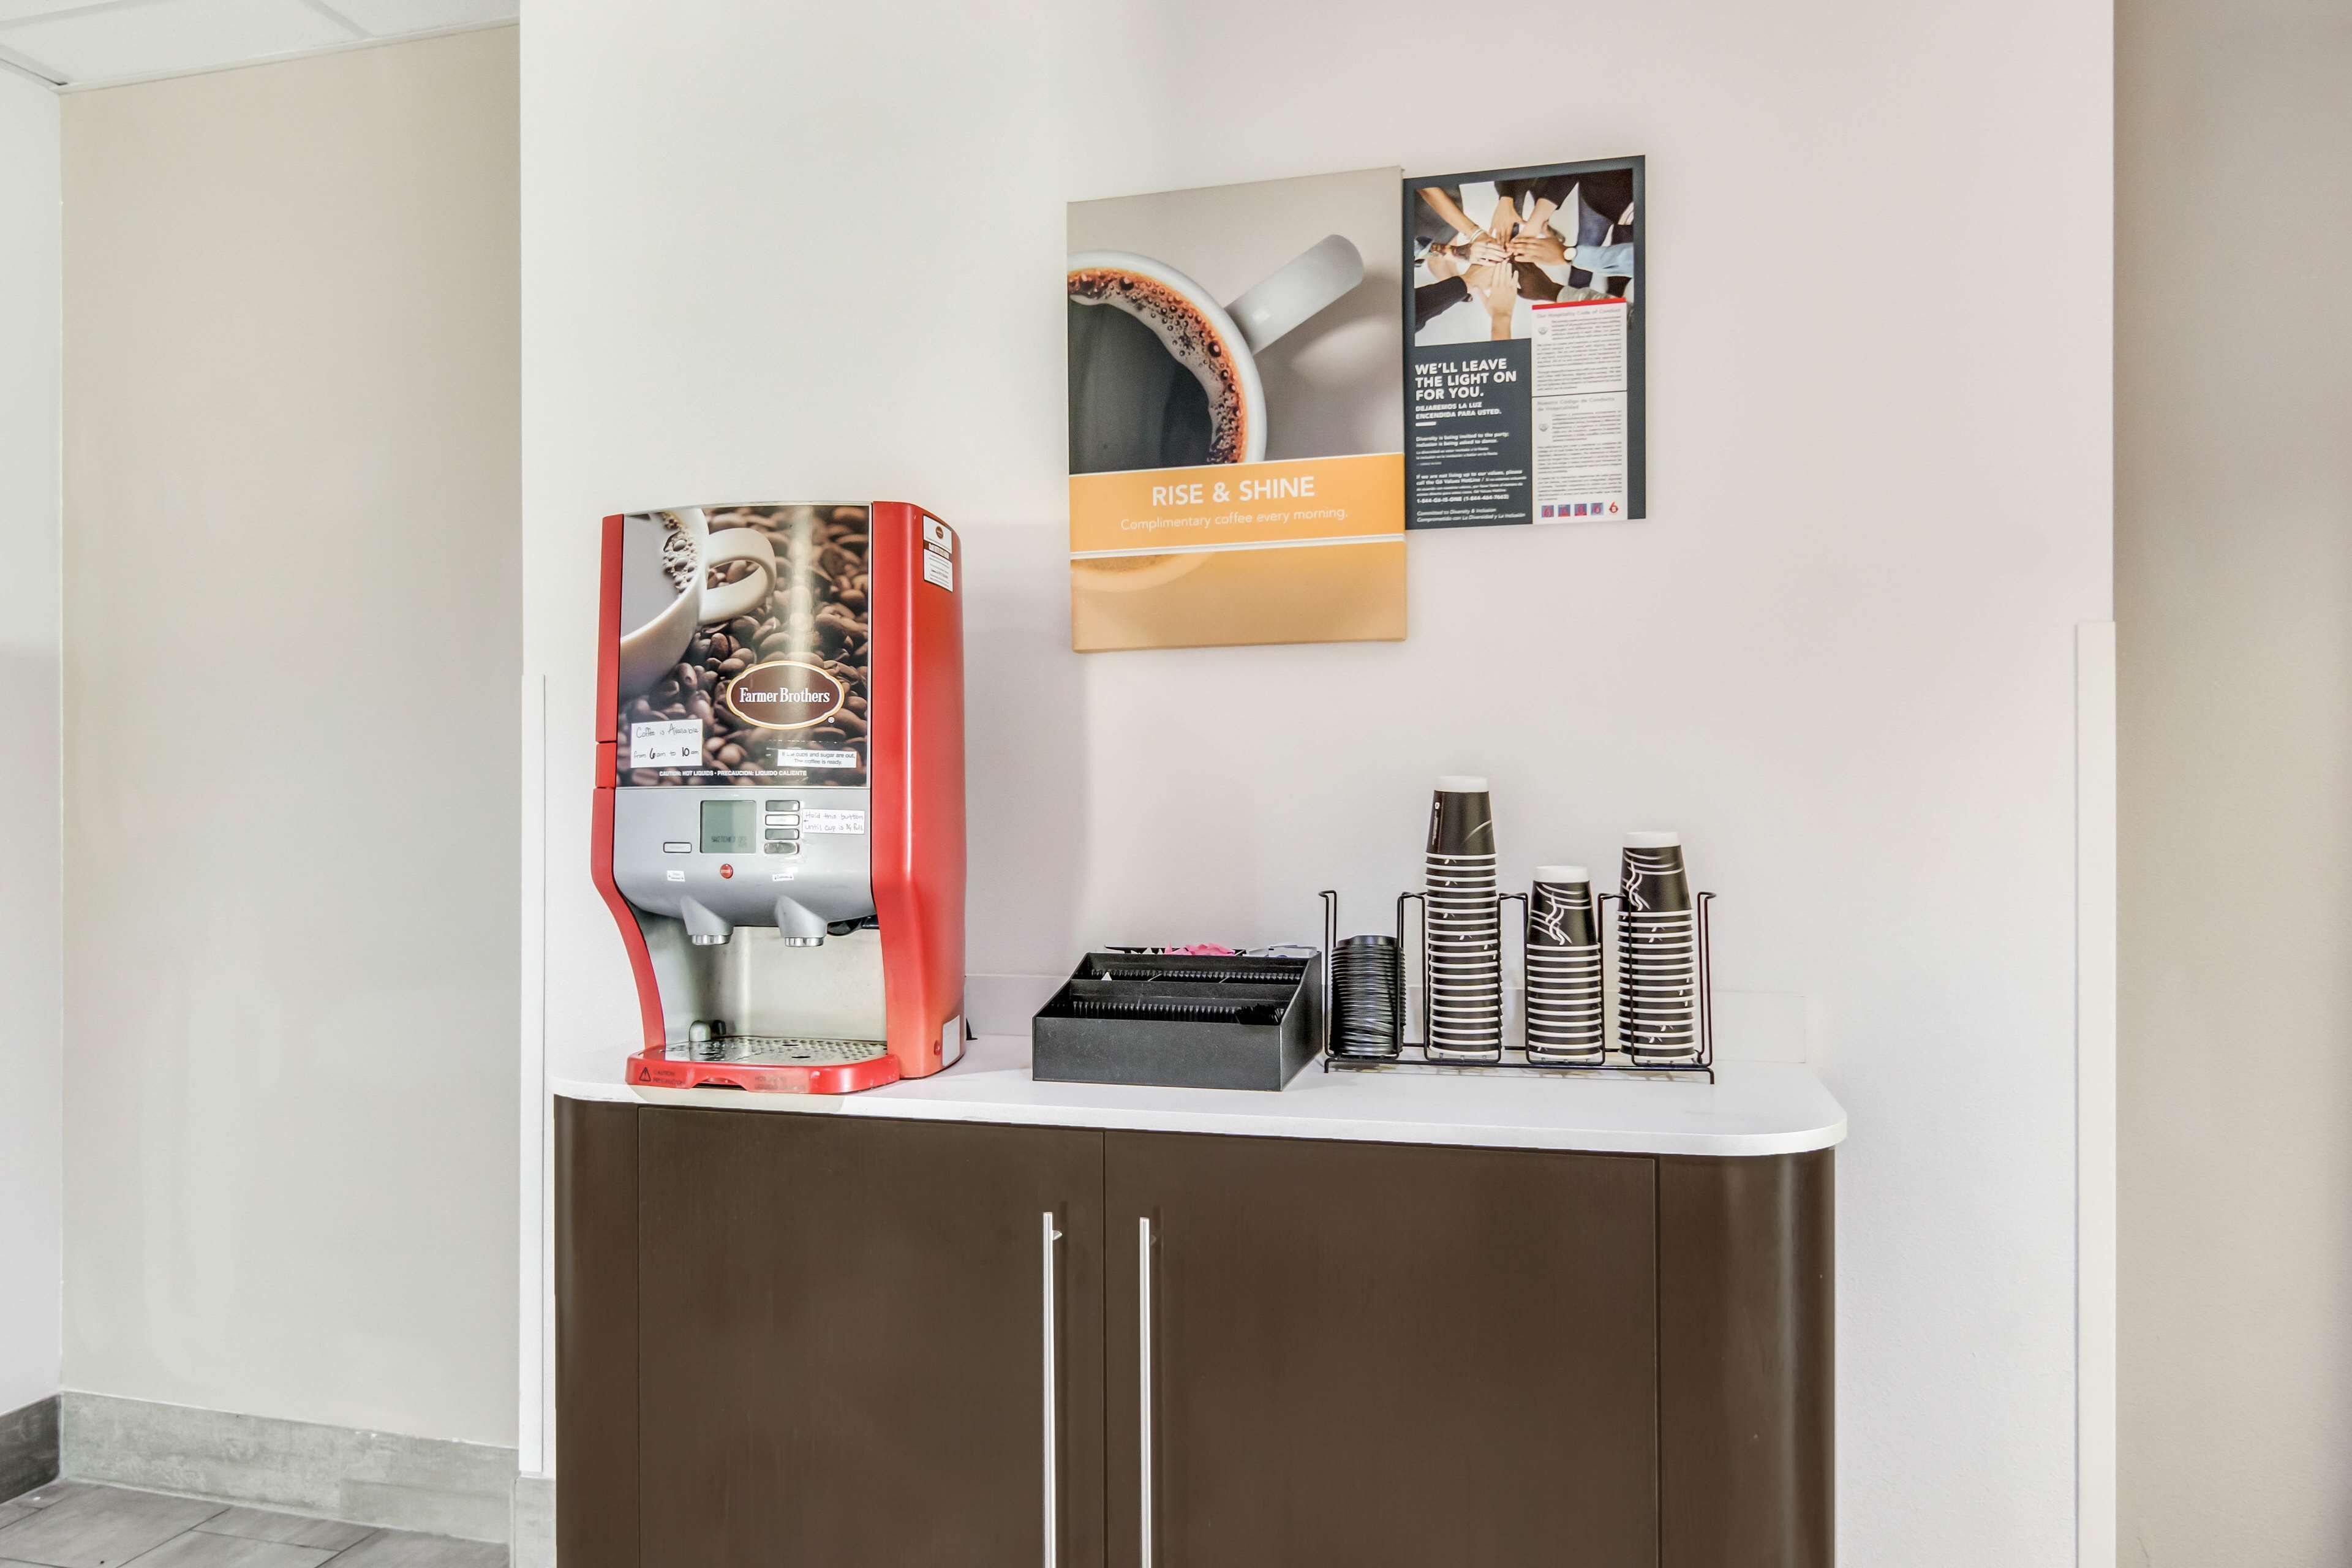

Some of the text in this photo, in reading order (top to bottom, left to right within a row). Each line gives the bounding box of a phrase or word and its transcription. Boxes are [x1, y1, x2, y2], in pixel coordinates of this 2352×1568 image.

[1415, 358, 1507, 375] WE'LL LEAVE
[1415, 371, 1517, 388] THE LIGHT ON
[1415, 386, 1484, 401] FOR YOU.
[1415, 403, 1457, 412] DEJAREMOS
[1415, 411, 1456, 420] ENCENDIDA
[1152, 476, 1315, 507] RISE & SHINE
[1120, 508, 1348, 534] Complimentary coffee every morning.
[739, 687, 830, 703] Farmer Brothers
